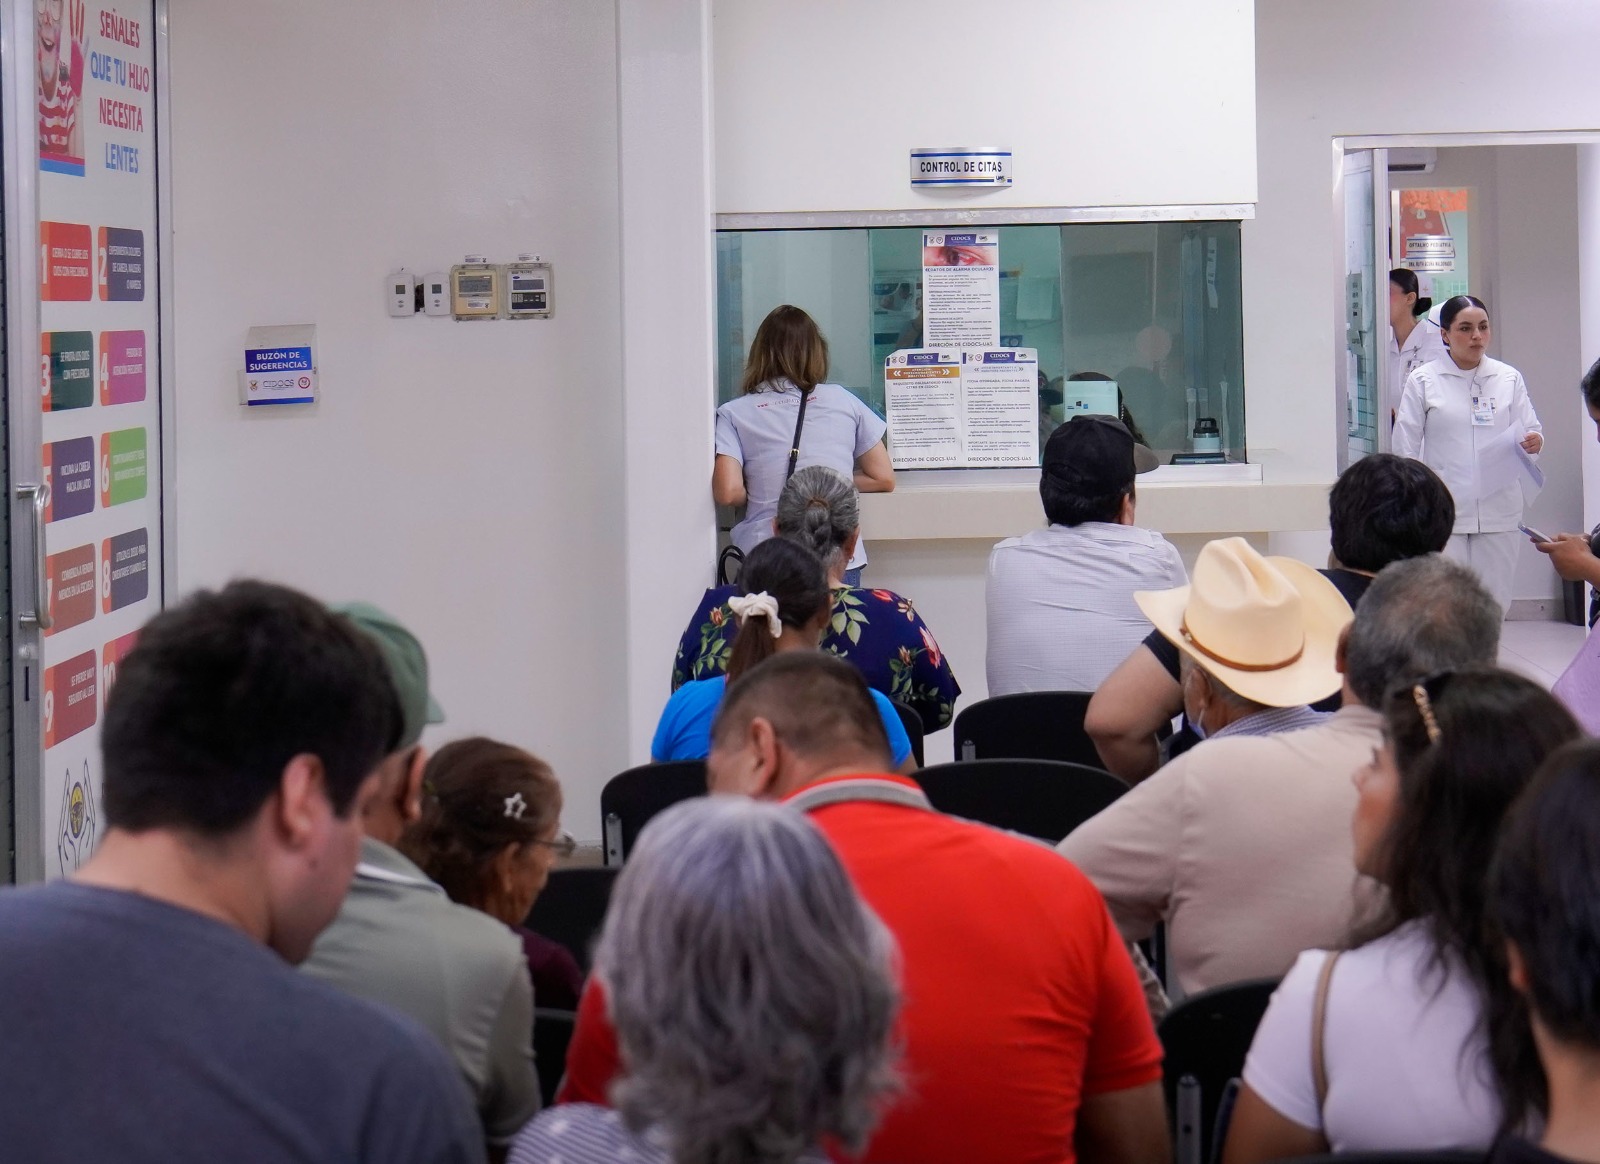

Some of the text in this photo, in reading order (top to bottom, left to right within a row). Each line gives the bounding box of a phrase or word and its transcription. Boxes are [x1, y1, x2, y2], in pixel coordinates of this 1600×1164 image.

[100, 8, 140, 48] SEÑALES
[91, 51, 150, 92] QUE TU HIJO
[99, 97, 144, 133] NECESITA
[106, 142, 138, 174] LENTES
[920, 161, 1002, 172] CONTROL DE CITAS
[99, 247, 107, 285] 2
[101, 352, 109, 390] 4
[250, 361, 308, 370] SUGERENCIAS
[256, 351, 286, 360] BUZÓN
[41, 354, 50, 396] 3
[102, 454, 109, 492] 6
[103, 560, 110, 598] 8
[45, 690, 54, 733] 9
